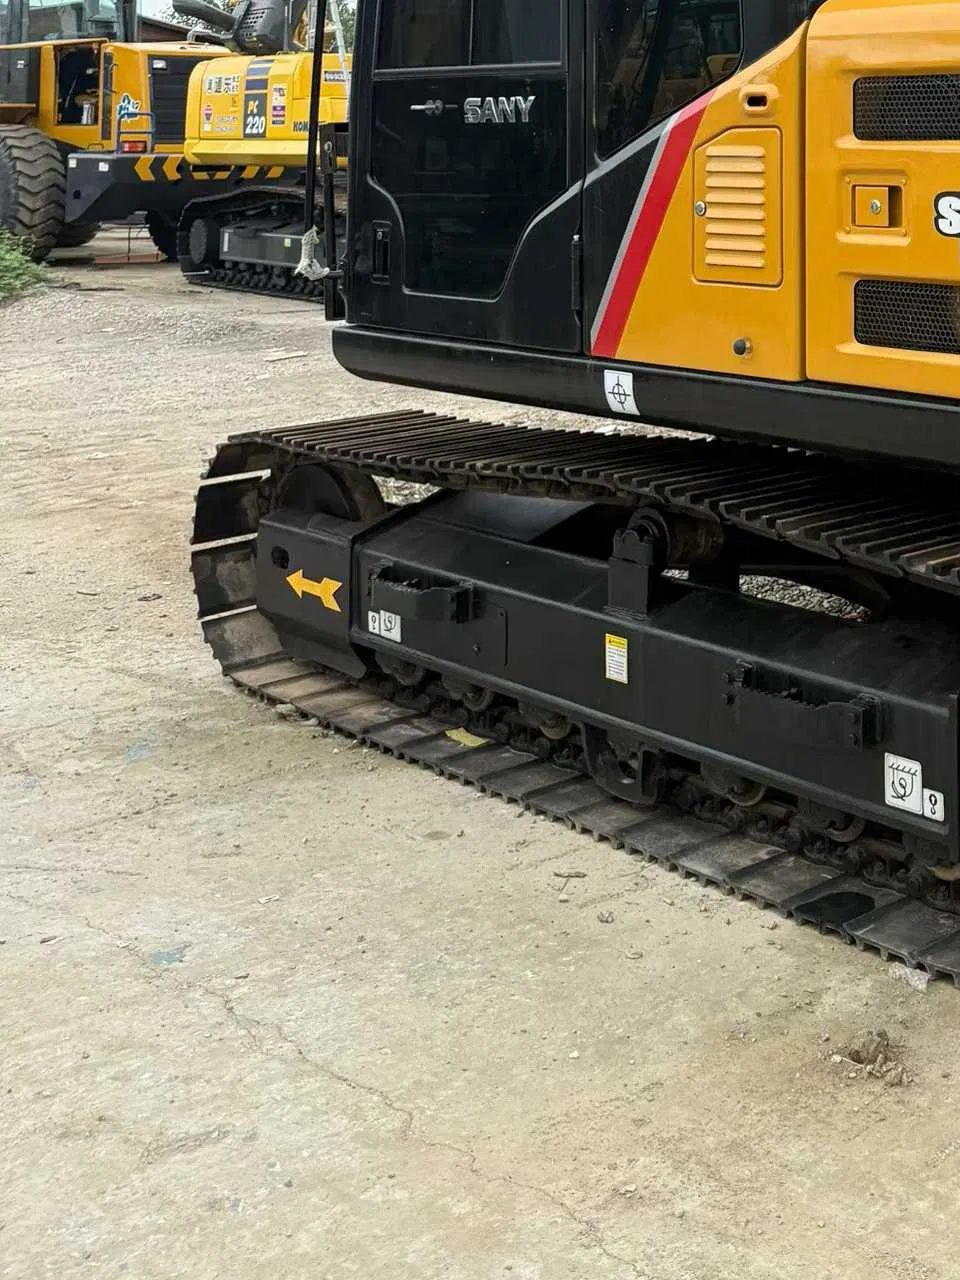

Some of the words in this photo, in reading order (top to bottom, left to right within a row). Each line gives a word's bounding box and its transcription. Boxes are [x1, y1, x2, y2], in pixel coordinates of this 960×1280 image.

[247, 100, 258, 115] PC
[464, 96, 536, 123] SANY
[245, 115, 265, 134] 220
